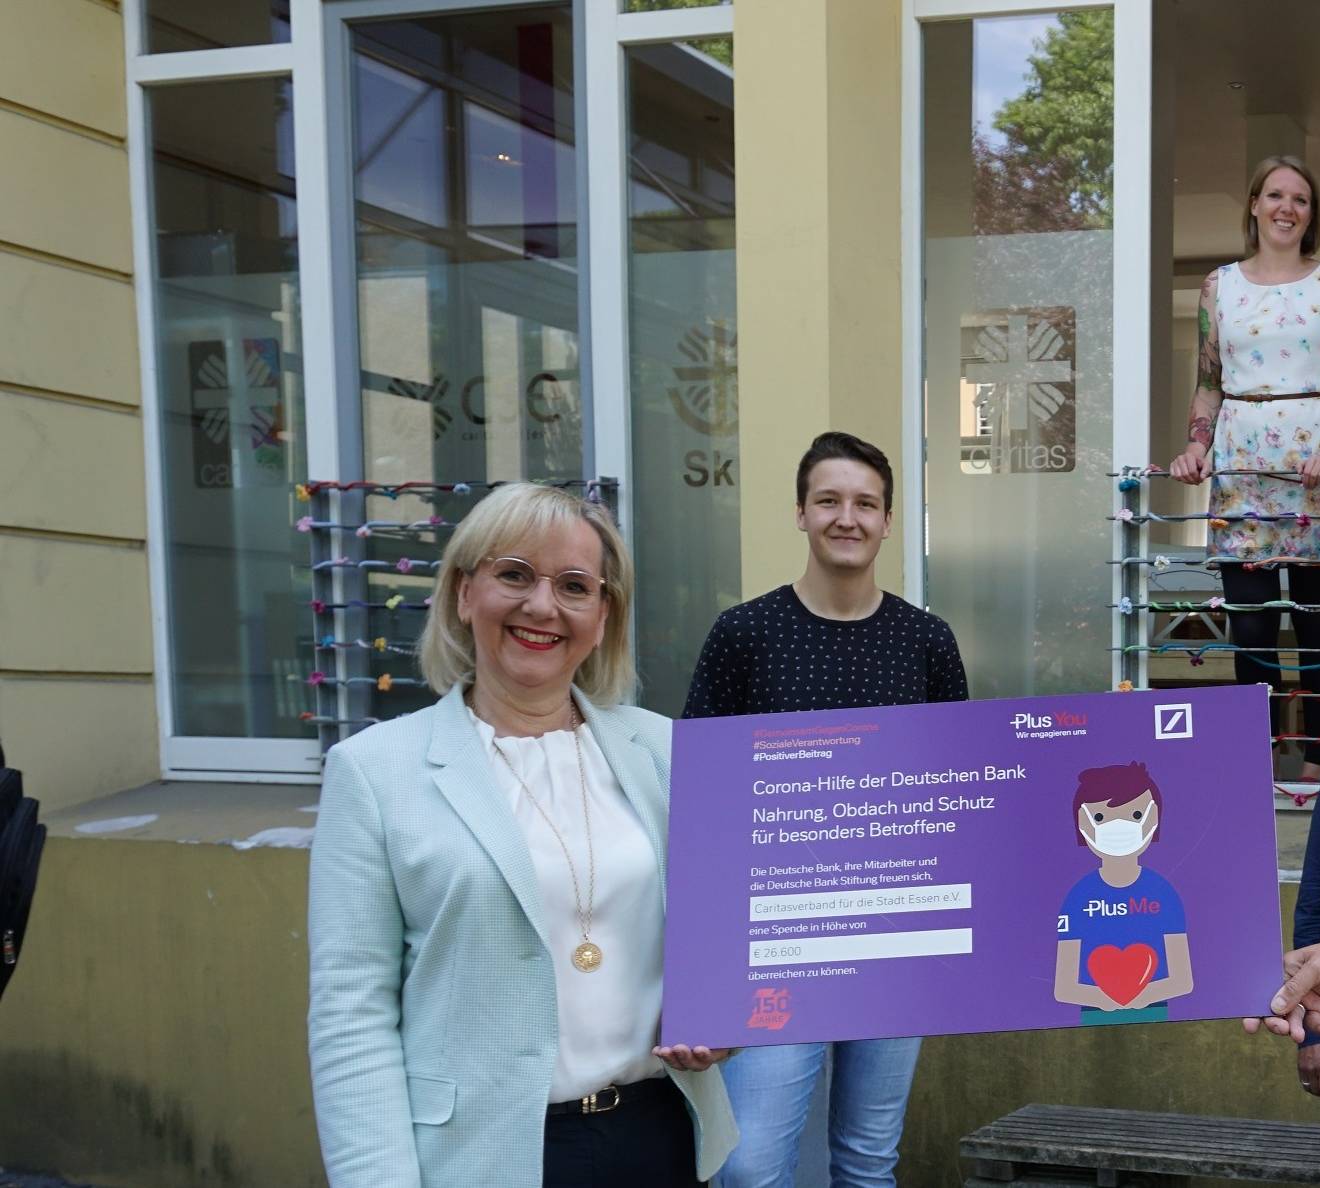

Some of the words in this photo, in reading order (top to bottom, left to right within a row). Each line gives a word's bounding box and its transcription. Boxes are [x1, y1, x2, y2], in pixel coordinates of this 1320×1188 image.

[969, 440, 1067, 470] caritas
[1054, 711, 1088, 727] You
[1016, 731, 1029, 739] Wir
[1030, 730, 1072, 739] engagieren
[1073, 729, 1087, 737] uns
[753, 735, 861, 750] #SozialeVerantwortung
[752, 749, 833, 762] #PositiverBeitrag
[753, 775, 856, 795] Corona-Hilfe
[859, 774, 887, 790] der
[891, 768, 979, 787] Deutschen
[984, 764, 1026, 782] Bank
[753, 806, 828, 824] Nahrung,
[833, 801, 898, 818] Obdach
[902, 798, 933, 814] und
[938, 795, 995, 811] Schutz
[751, 829, 775, 845] für
[779, 824, 865, 843] besonders
[869, 820, 956, 837] Betroffene
[751, 867, 767, 877] Die
[769, 864, 814, 876] Deutsche
[816, 863, 842, 874] Bank,
[844, 862, 863, 871] ihre
[864, 858, 916, 870] Mitarbeiter
[918, 856, 937, 866] und
[750, 881, 765, 891] die
[767, 879, 812, 890] Deutsche
[814, 877, 838, 887] Bank
[840, 874, 878, 886] Stiftung
[879, 873, 910, 883] freuen
[911, 871, 933, 882] sich,
[754, 900, 836, 914] Caritasverband
[839, 898, 854, 909] für
[857, 897, 873, 908] die
[876, 894, 905, 906] Stadt
[908, 893, 940, 904] Essen
[943, 891, 961, 902] e.V.
[749, 927, 769, 936] eine
[771, 924, 808, 936] Spende
[810, 923, 820, 932] in
[821, 920, 848, 931] Höhe
[849, 921, 867, 930] von
[754, 949, 761, 959] €
[763, 946, 802, 958] 26.600
[748, 968, 805, 981] überreichen
[807, 969, 819, 978] zu
[820, 966, 858, 977] können.
[752, 997, 791, 1013] 150
